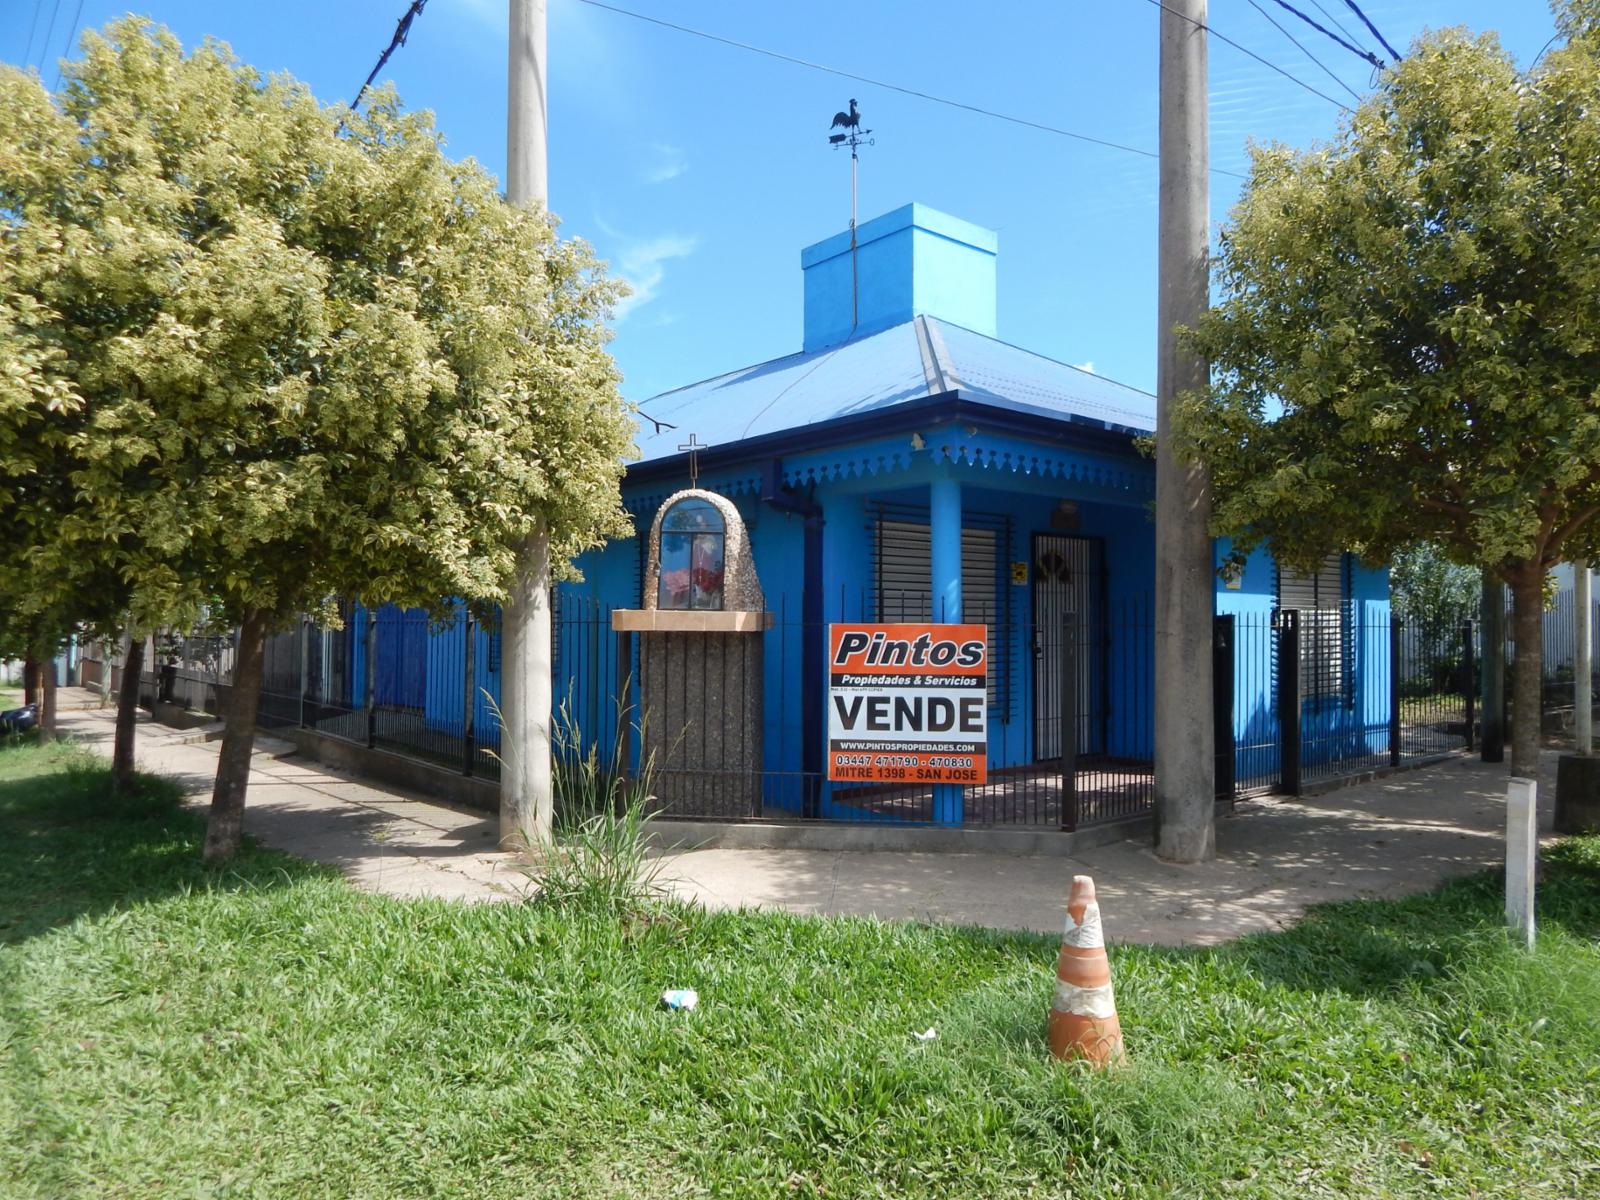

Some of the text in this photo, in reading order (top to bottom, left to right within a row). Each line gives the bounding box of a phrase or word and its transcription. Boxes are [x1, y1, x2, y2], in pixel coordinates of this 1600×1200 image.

[834, 632, 984, 667] Pintos
[842, 675, 977, 685] Propiedades & Servicios
[834, 696, 983, 732] VENDE
[840, 742, 974, 752] WWW.PINTOSPROPIEDADES.COM
[836, 756, 871, 765] 03447
[875, 756, 918, 767] 471790
[930, 757, 972, 767] 470830
[836, 767, 872, 778] MITRE
[879, 768, 905, 778] 1398
[917, 770, 940, 779] SAN
[946, 770, 977, 780] JOSE
